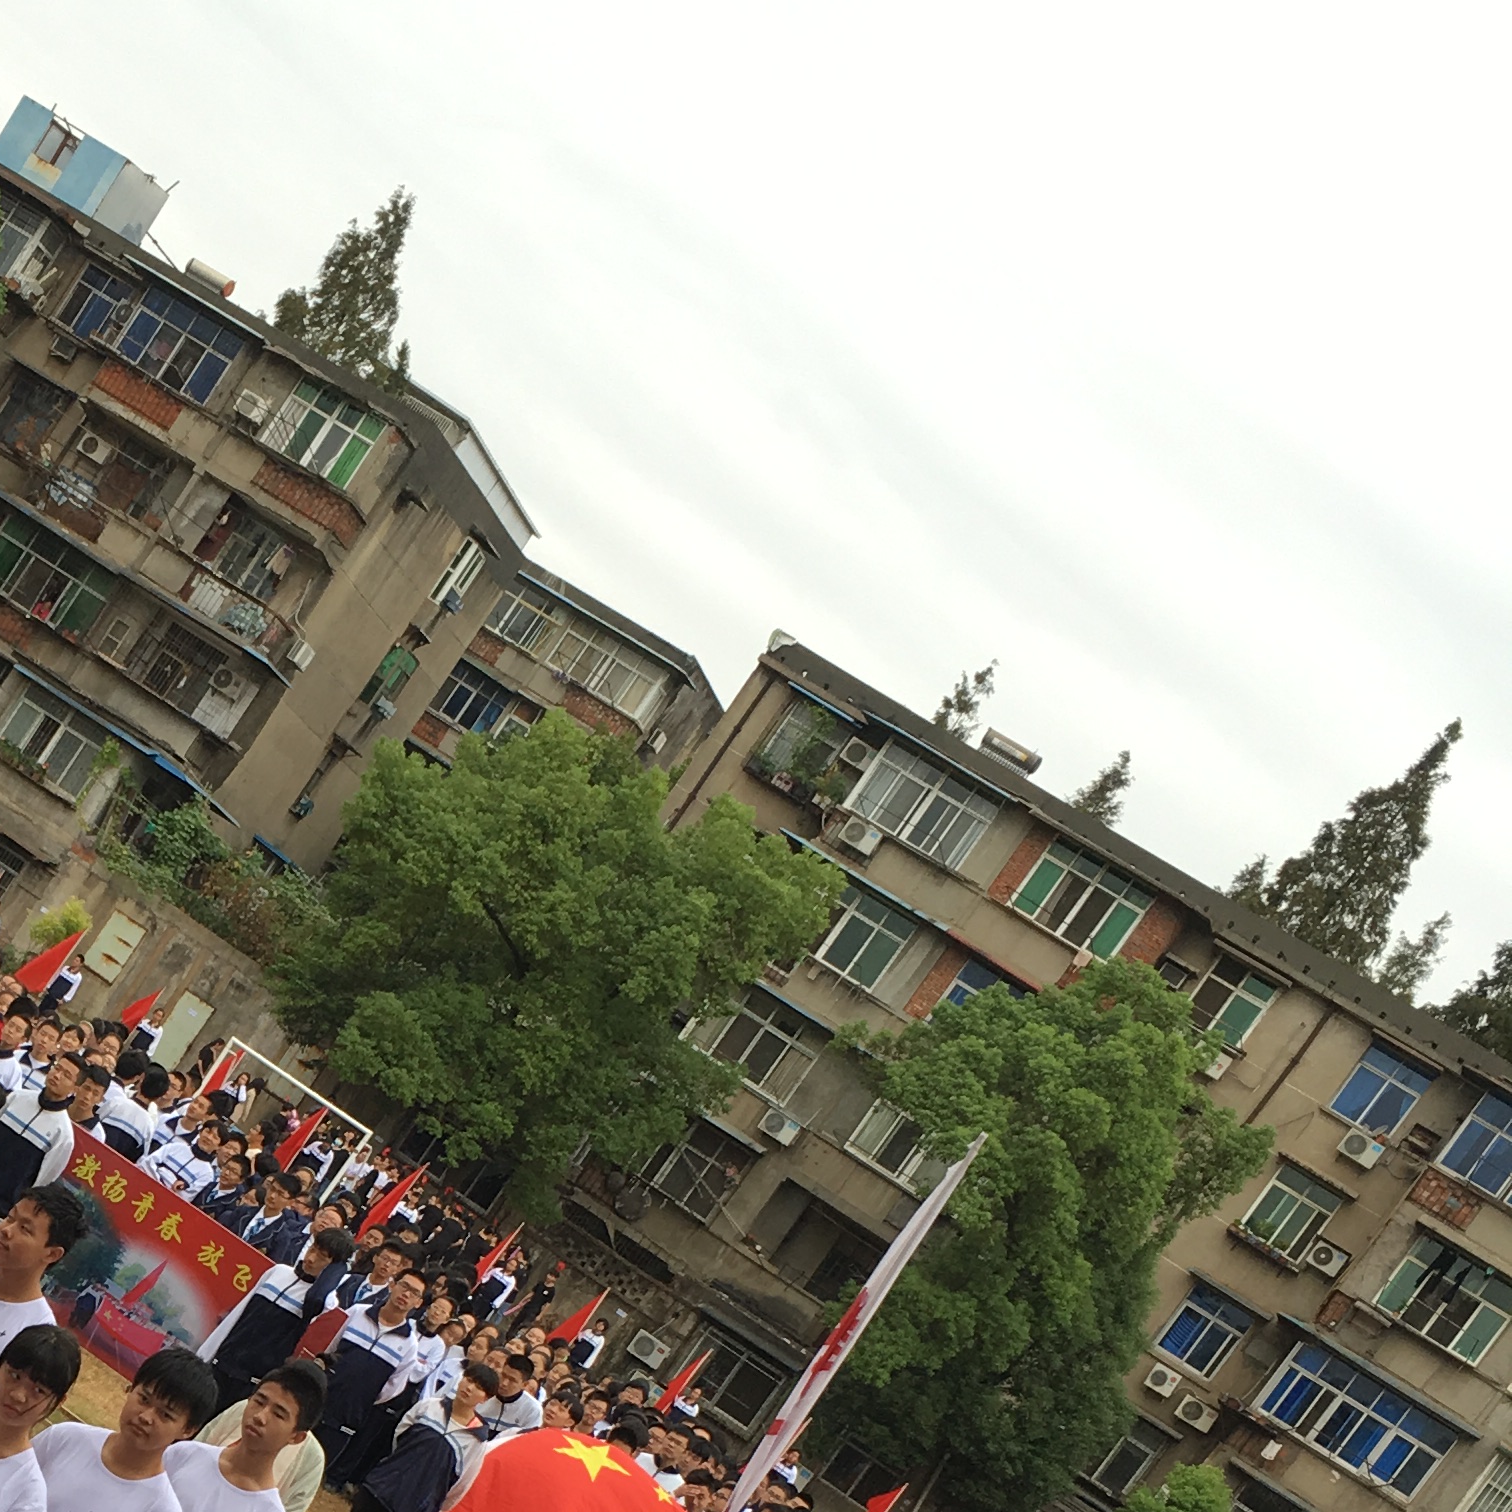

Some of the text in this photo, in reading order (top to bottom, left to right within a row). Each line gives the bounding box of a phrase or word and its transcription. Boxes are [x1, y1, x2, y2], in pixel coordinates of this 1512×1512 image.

[72, 1152, 253, 1292] 激扬青春 放飞
